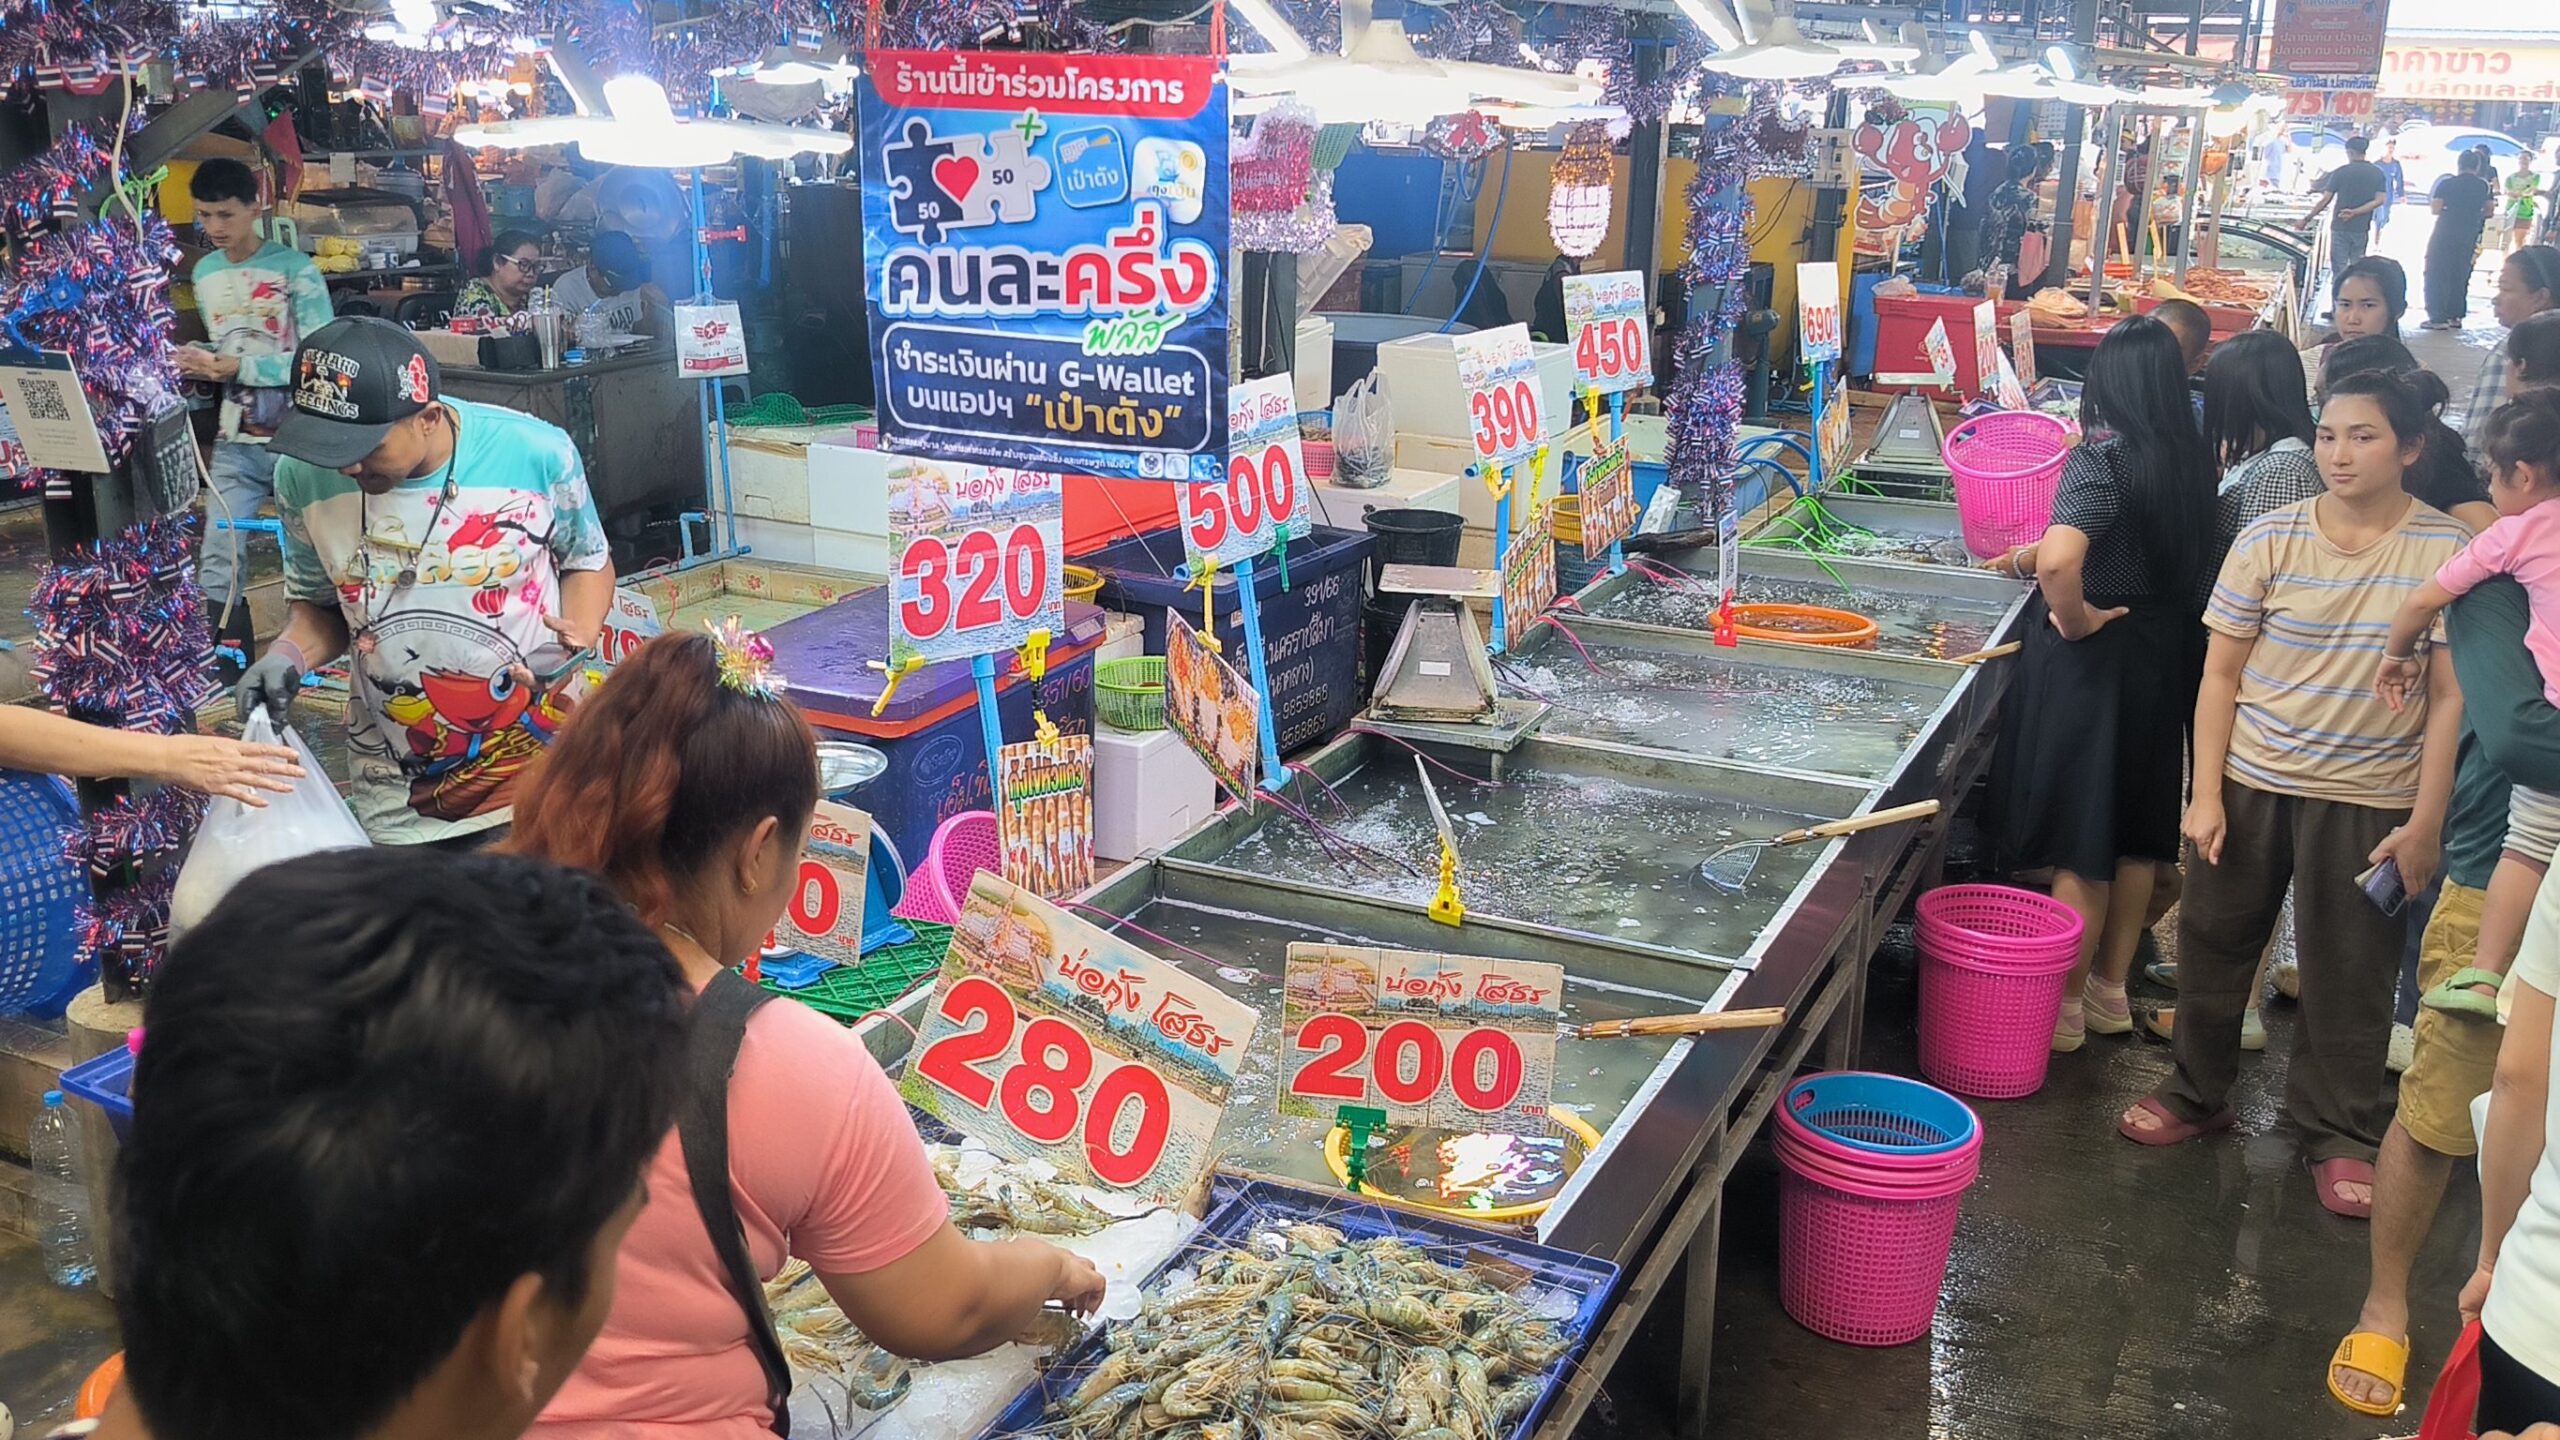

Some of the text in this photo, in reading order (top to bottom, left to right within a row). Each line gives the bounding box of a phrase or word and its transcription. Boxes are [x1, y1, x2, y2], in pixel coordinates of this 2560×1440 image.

[896, 56, 1185, 105] ร้านนี้เข้าร่วมโครงการ
[992, 168, 1015, 185] 50
[1066, 165, 1120, 192] เป๋าตัง
[917, 202, 941, 219] 50
[887, 210, 1208, 306] คนละครึ่ง
[1086, 310, 1182, 352] พลัส
[1807, 307, 1833, 343] 690
[894, 340, 1196, 397] ชำระเงินผ่าน G-Wallet
[1577, 318, 1642, 378] 450
[907, 385, 1014, 420] บนแอปฯ
[1230, 399, 1254, 431] อกุ้ง
[1472, 381, 1538, 456] 390
[1188, 445, 1294, 550] 500
[901, 524, 1047, 639] 320
[1304, 575, 1340, 607] 391/66
[1058, 948, 1235, 1056] บ่อกุ้ง โสธร
[1385, 967, 1552, 1005] บ่อกุ้ง โสธร
[916, 976, 1172, 1185] 280
[1291, 1013, 1524, 1112] 200
[1520, 1103, 1544, 1116] บาท
